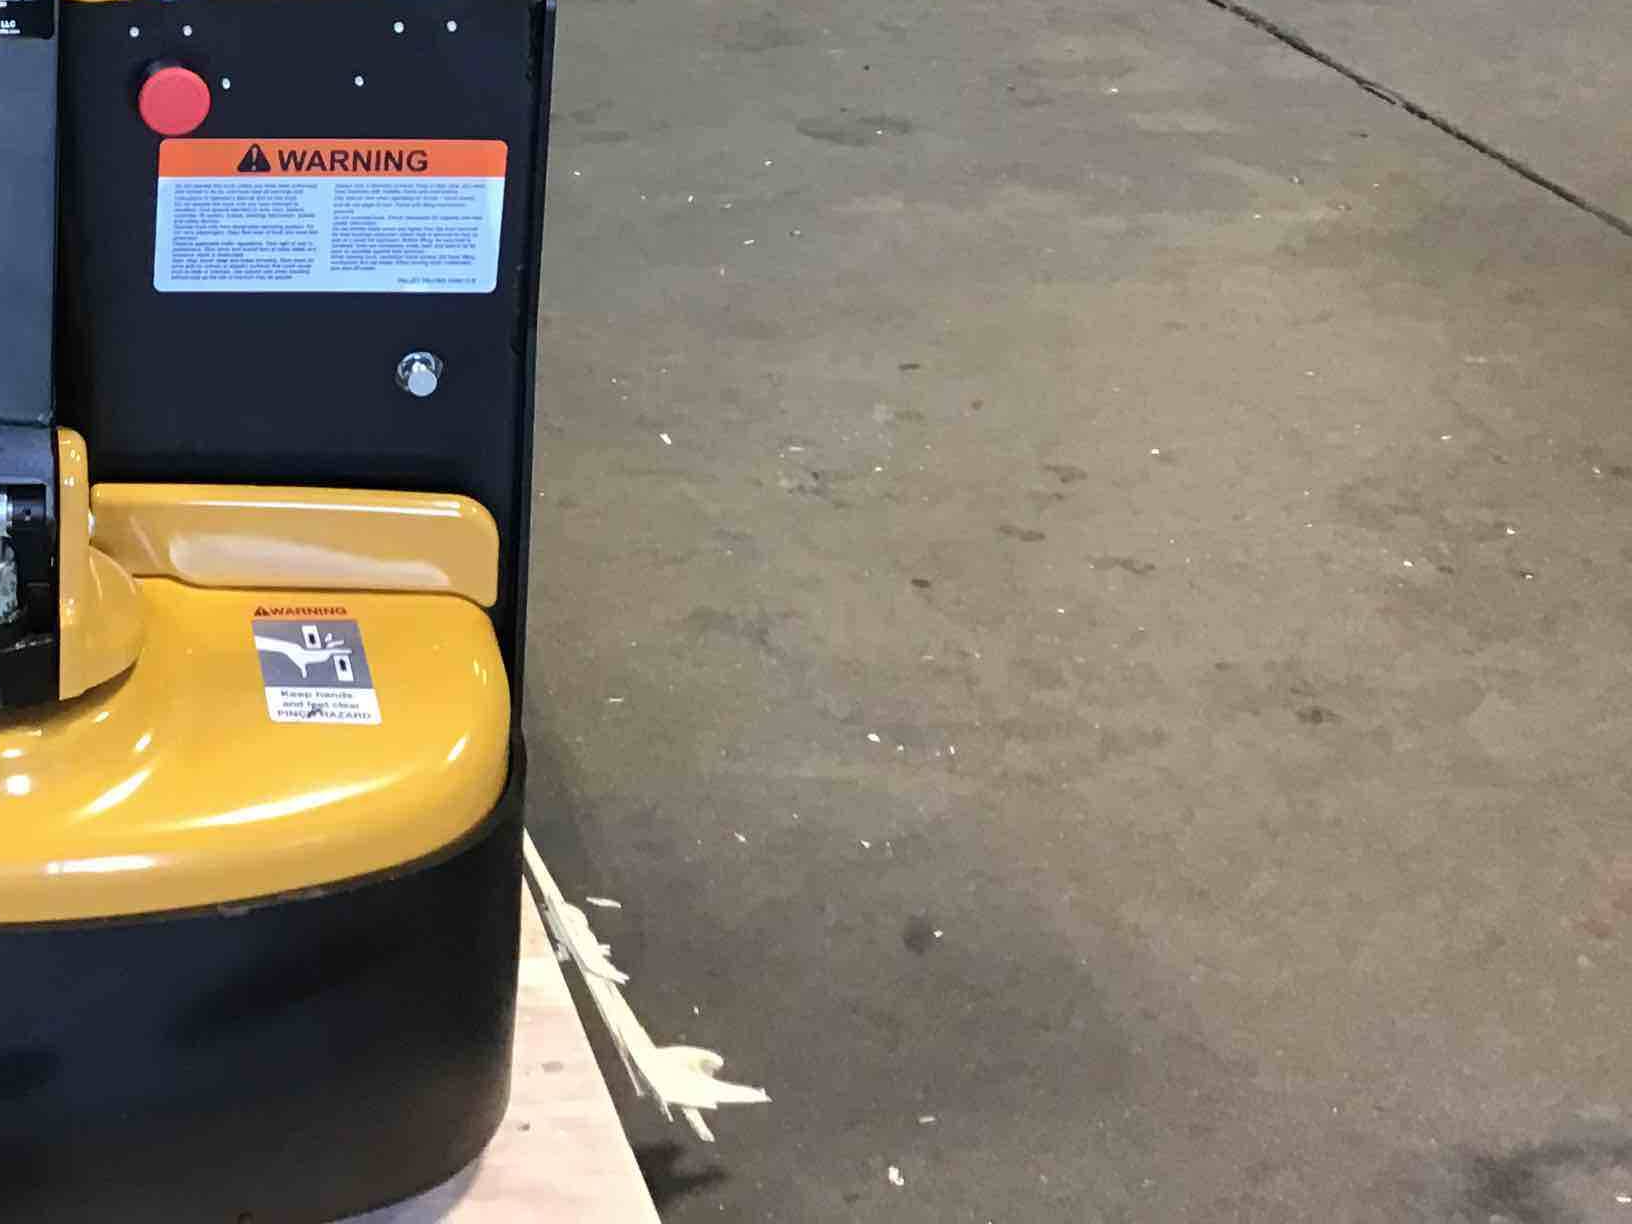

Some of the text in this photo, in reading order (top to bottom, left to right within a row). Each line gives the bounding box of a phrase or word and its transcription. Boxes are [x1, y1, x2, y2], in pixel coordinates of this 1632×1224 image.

[277, 148, 429, 173] WARNING
[270, 606, 347, 616] WARNING
[280, 689, 353, 699] Keep hands
